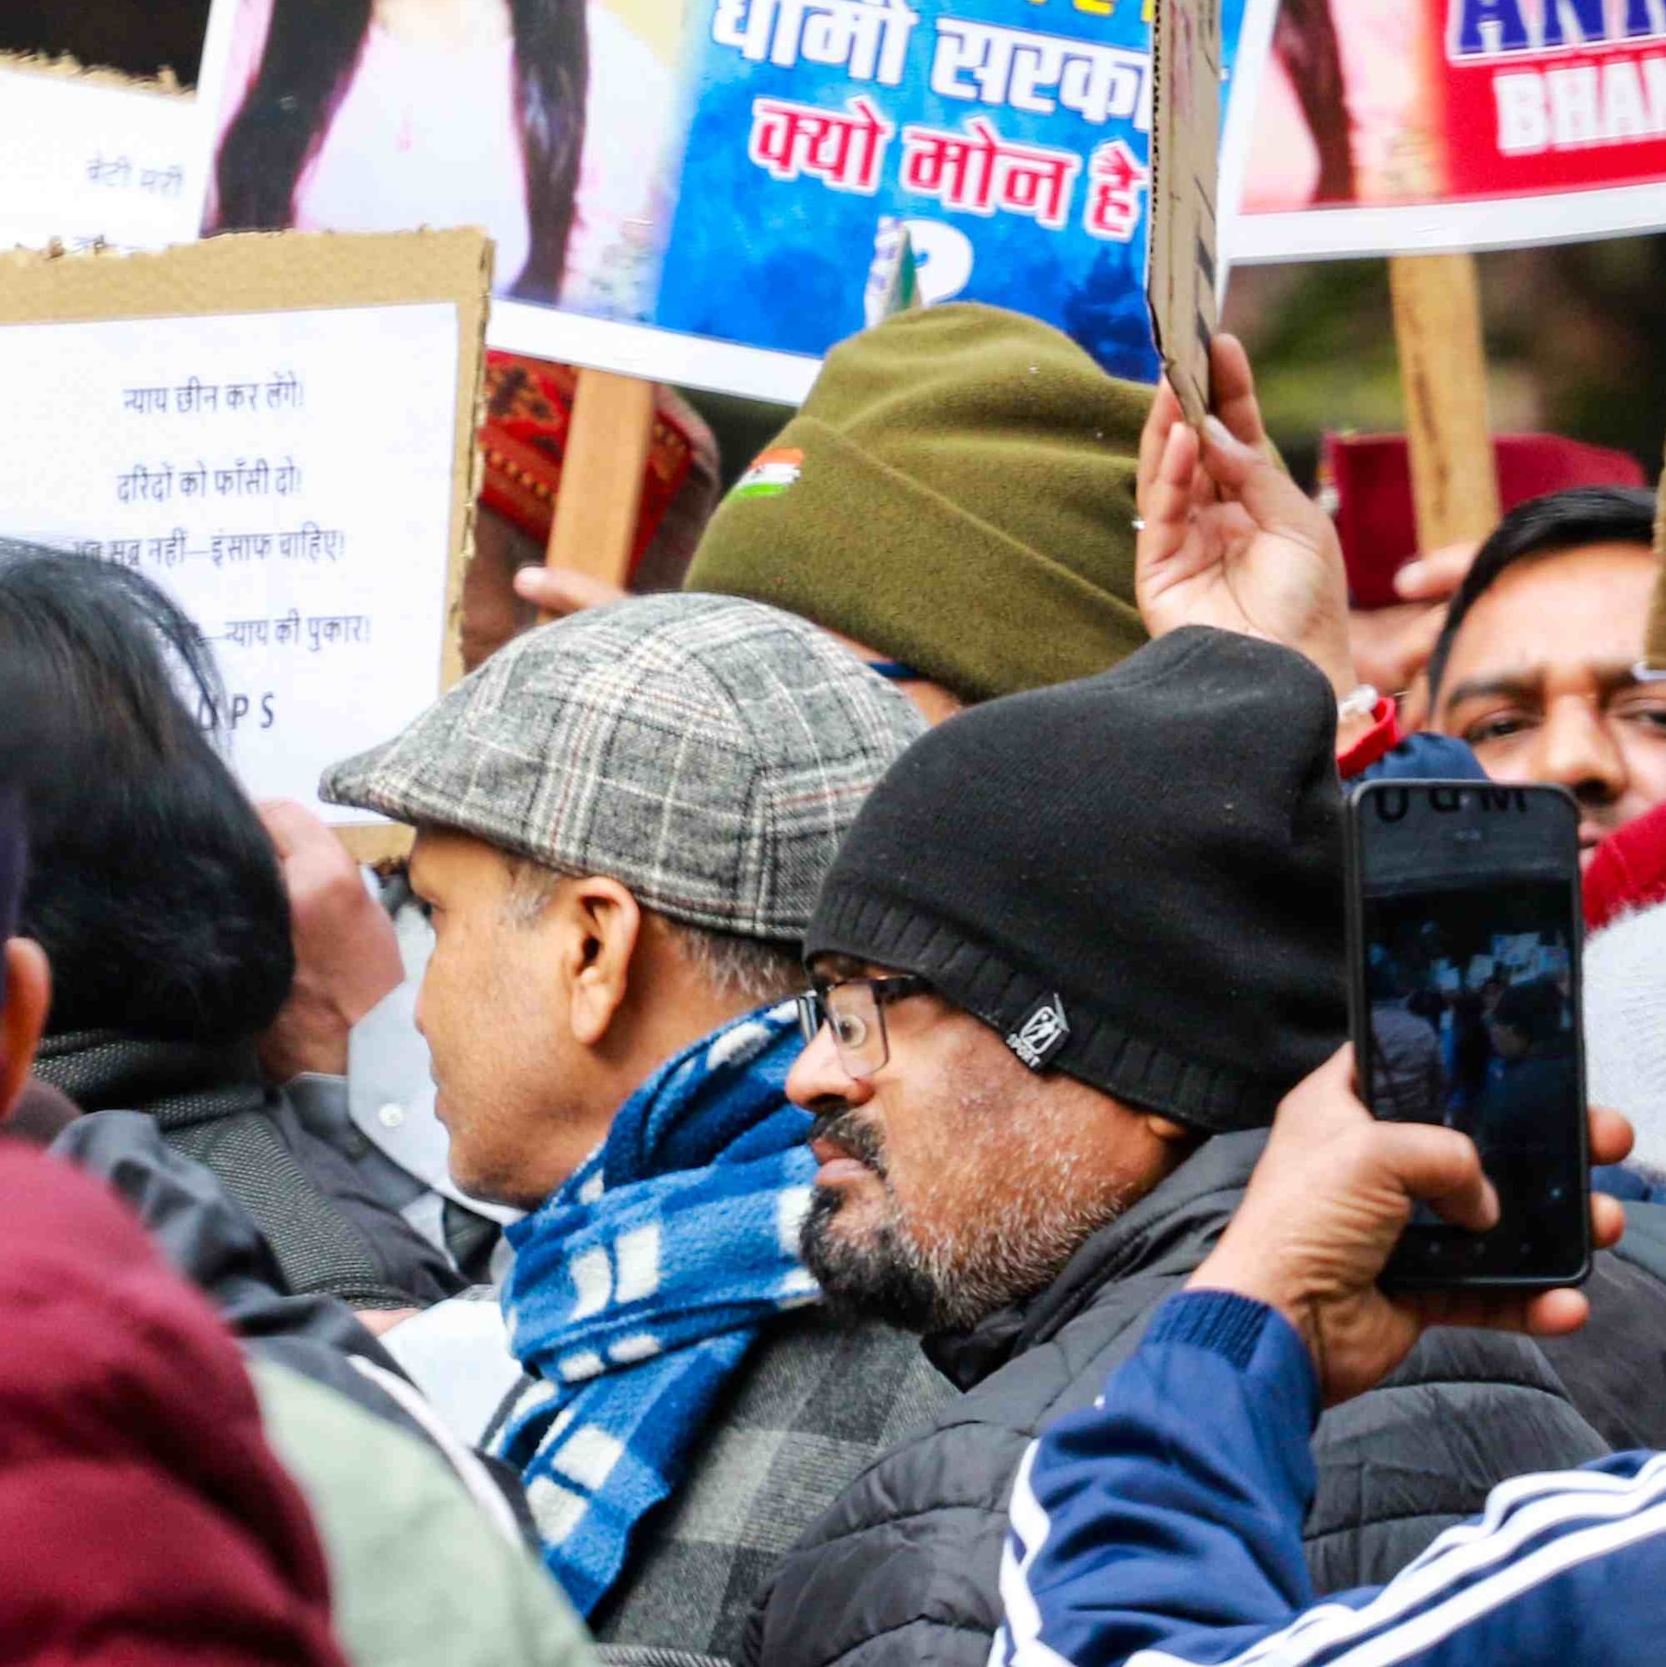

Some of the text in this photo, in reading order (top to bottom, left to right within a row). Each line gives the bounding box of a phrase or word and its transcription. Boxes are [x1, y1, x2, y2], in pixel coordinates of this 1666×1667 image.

[932, 17, 1153, 131] सरका
[748, 94, 1150, 242] क्यो मोन है
[122, 387, 169, 414] न्याय
[174, 375, 219, 413] छीन
[225, 383, 260, 411] कर
[179, 460, 207, 498] को
[213, 457, 270, 496] फाँसी
[275, 608, 300, 645] की
[307, 615, 370, 652] पुकार!
